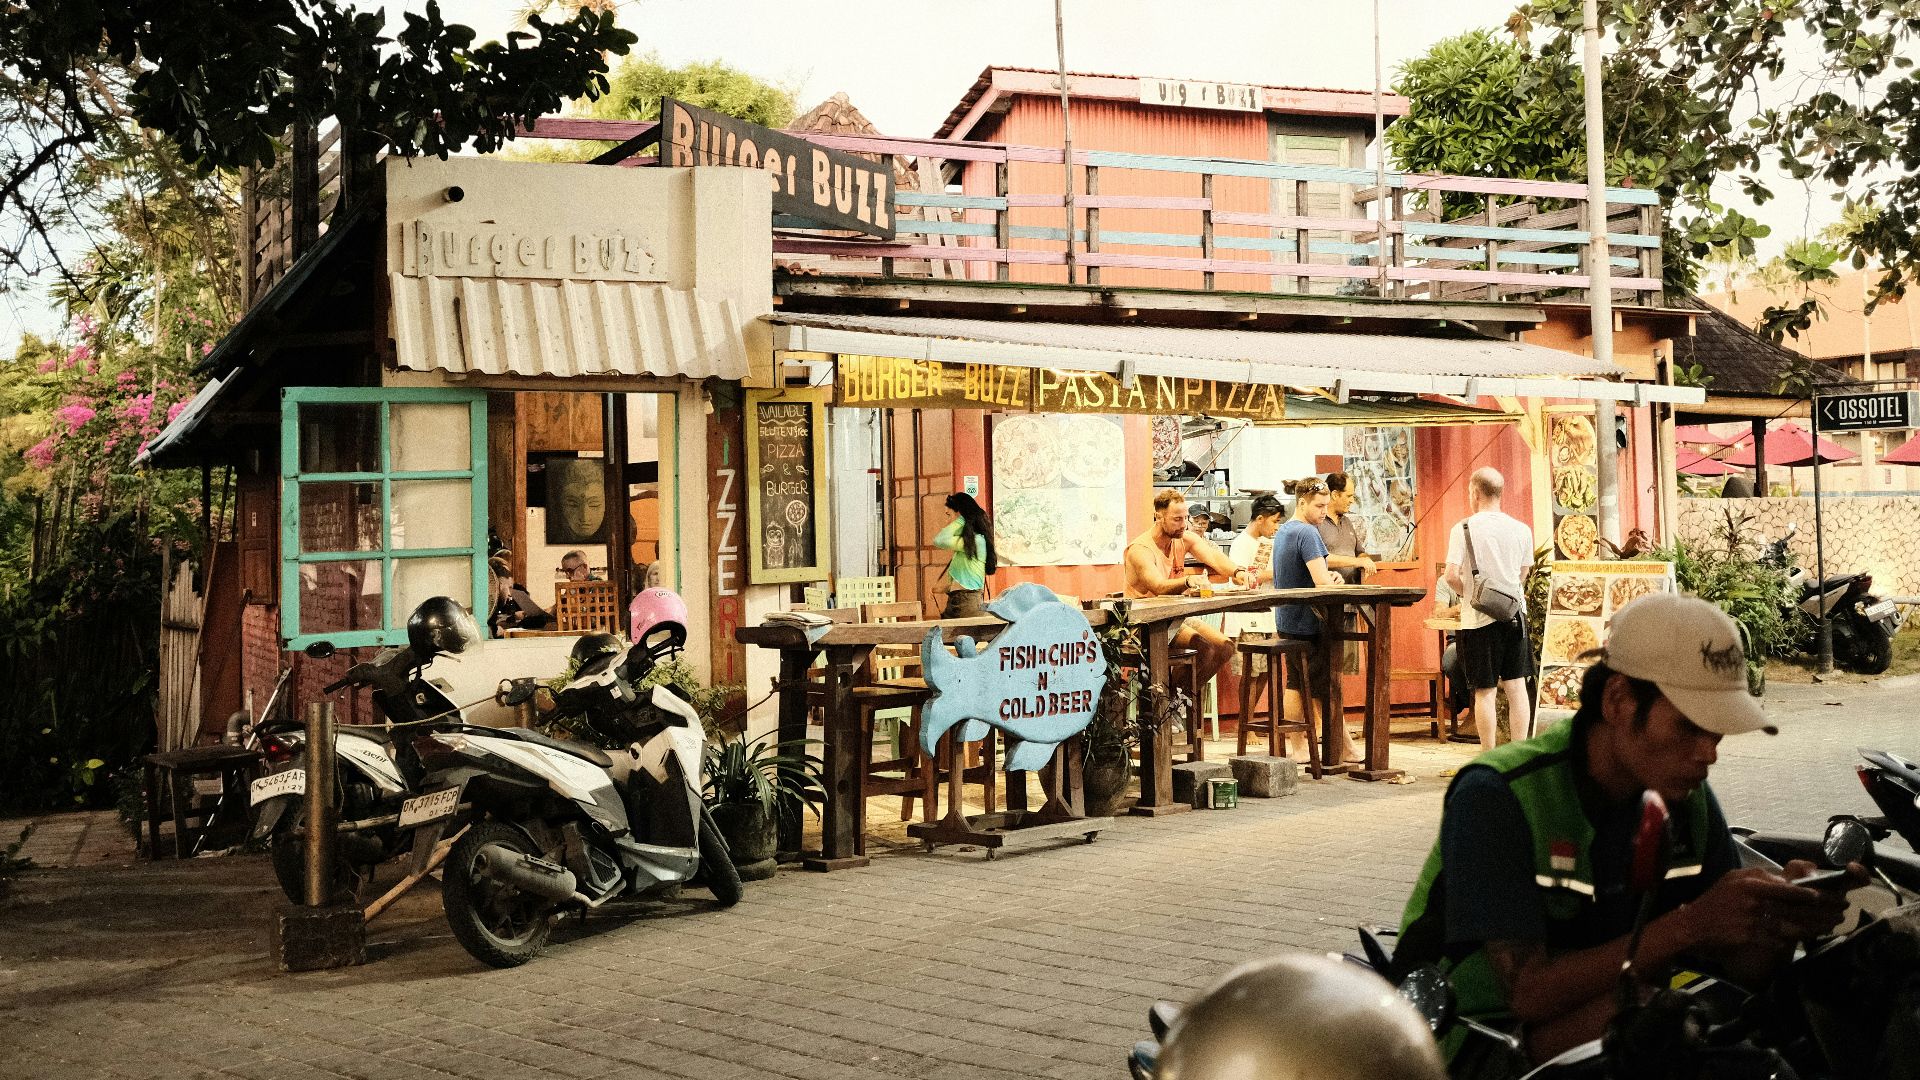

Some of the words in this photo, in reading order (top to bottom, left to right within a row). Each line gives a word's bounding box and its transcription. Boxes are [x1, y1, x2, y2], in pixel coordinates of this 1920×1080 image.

[812, 148, 889, 230] BUZZ
[844, 354, 943, 403] BURGER
[964, 363, 1024, 407] BUZZ
[1183, 379, 1281, 413] PIZZA
[760, 405, 808, 419] AVAILABLE
[1839, 397, 1902, 420] OSSOTEL
[768, 443, 805, 459] PIZZA
[782, 462, 791, 476] &
[766, 479, 809, 497] BURGER
[999, 645, 1036, 671] FISH
[1037, 671, 1047, 691] N
[999, 695, 1045, 721] COLD
[1048, 689, 1092, 716] BEER
[403, 800, 416, 813] DK
